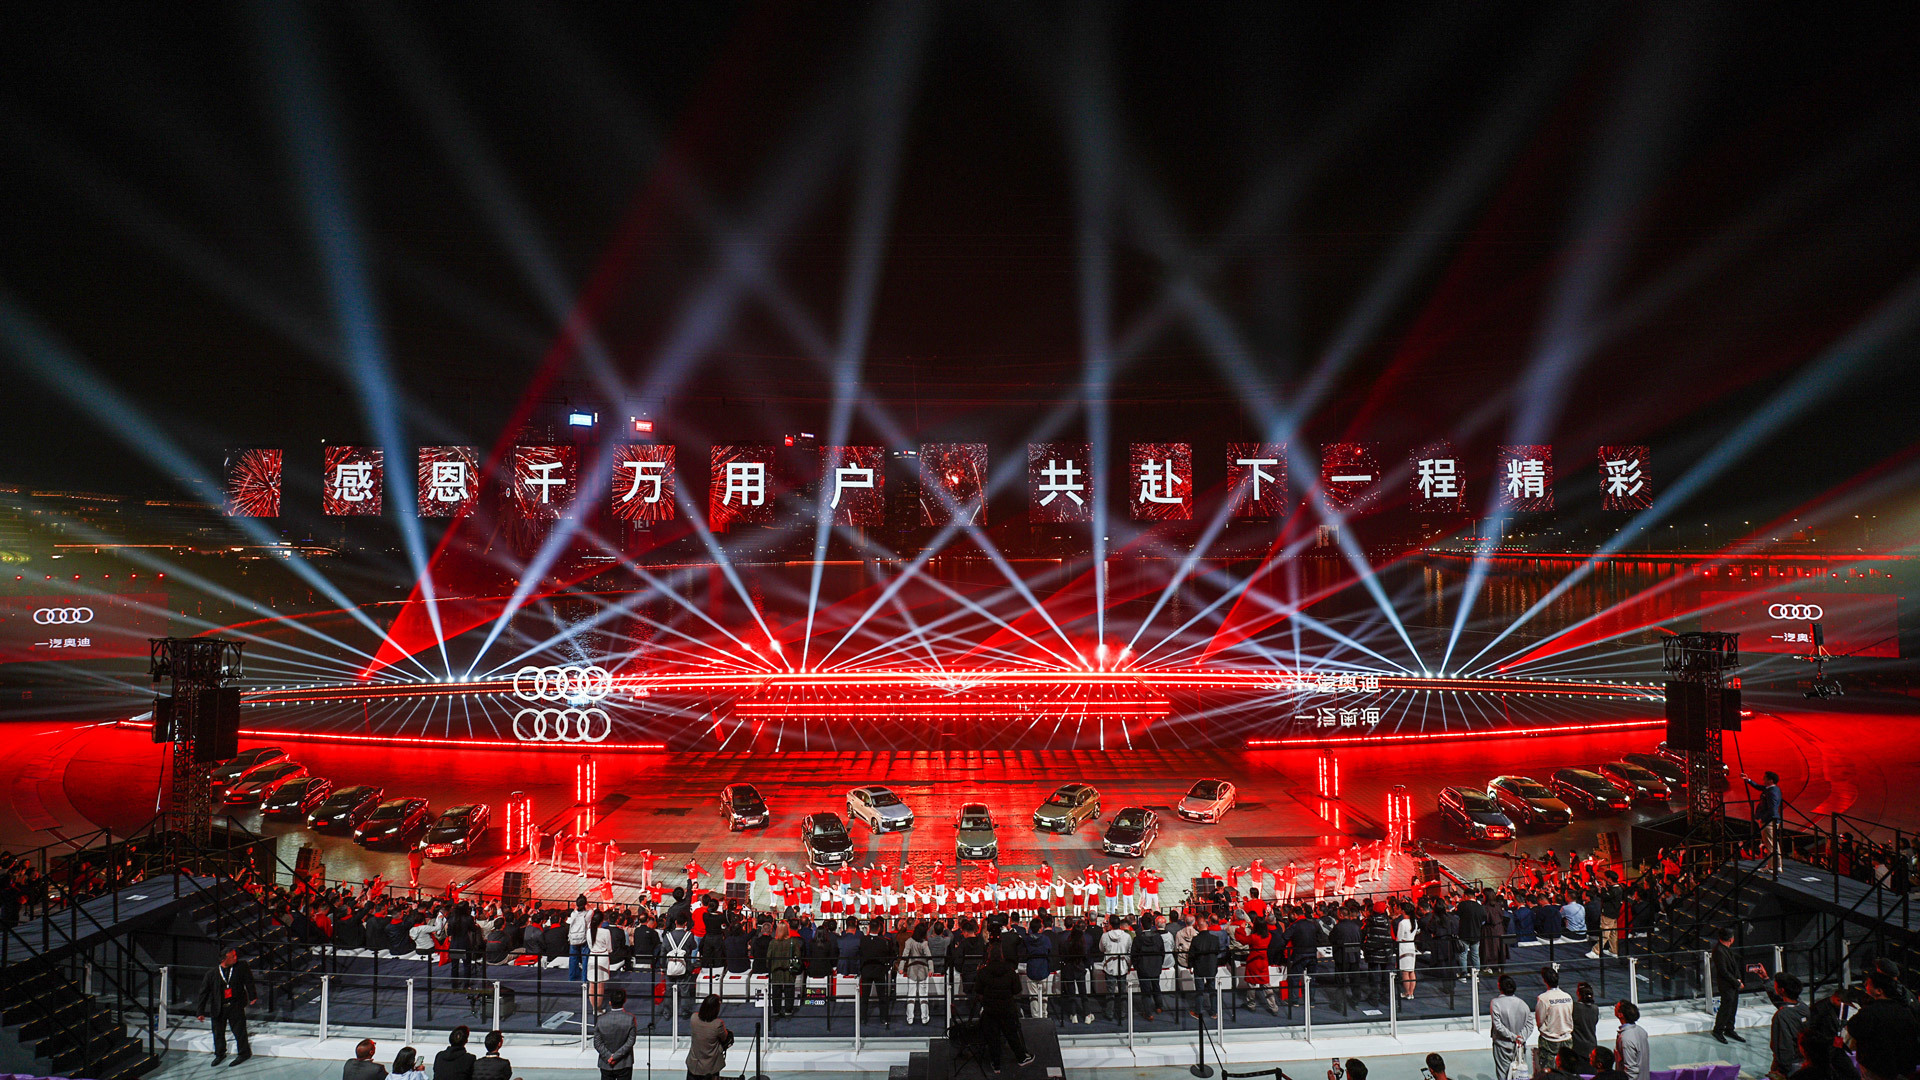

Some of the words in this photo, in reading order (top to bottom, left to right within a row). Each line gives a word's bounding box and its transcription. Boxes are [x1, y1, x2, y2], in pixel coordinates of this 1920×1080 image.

[34, 637, 91, 648] 一汽奥迪
[1771, 632, 1811, 643] 一汽奥
